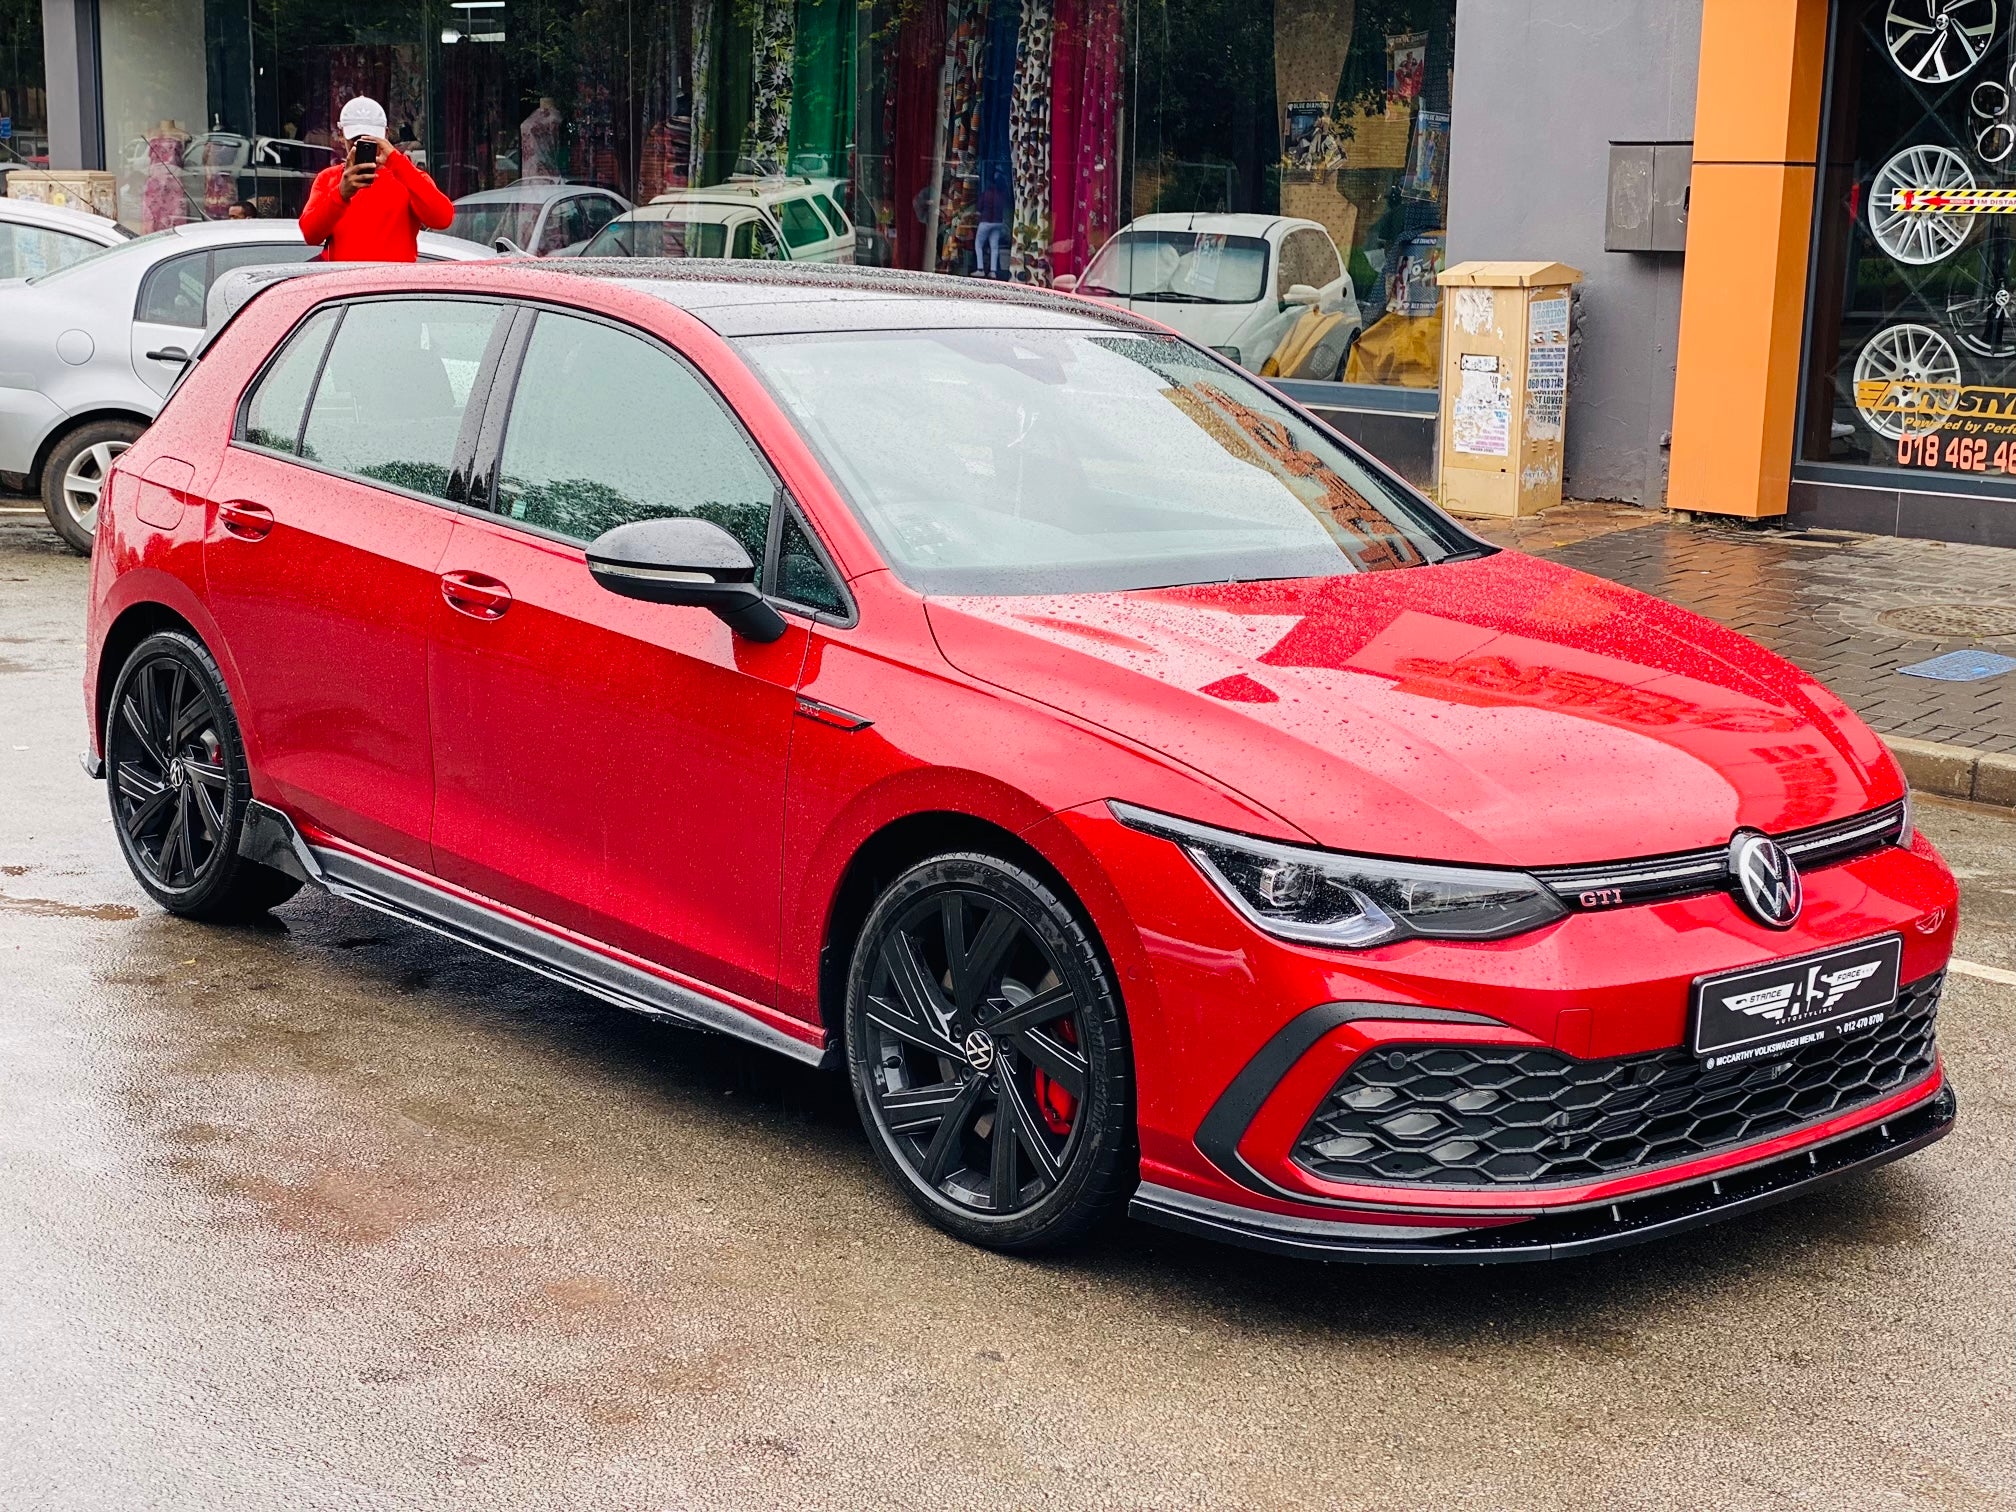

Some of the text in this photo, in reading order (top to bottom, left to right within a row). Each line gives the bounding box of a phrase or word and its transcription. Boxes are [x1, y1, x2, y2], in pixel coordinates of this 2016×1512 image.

[1543, 396, 1563, 405] LOVER
[1905, 416, 1963, 431] Powered
[1964, 420, 1981, 434] by
[1897, 432, 1940, 467] 018
[1945, 436, 1988, 471] 462
[1579, 888, 1623, 907] GTI
[1837, 969, 1861, 982] FORCE
[1749, 989, 1782, 1003] STANCE
[1775, 1006, 1833, 1025] AUTOSTYLING
[1843, 1013, 1884, 1033] 012 470 8700
[1716, 1030, 1825, 1067] MCCARTHY VOLKSWAGEN MENLYN
